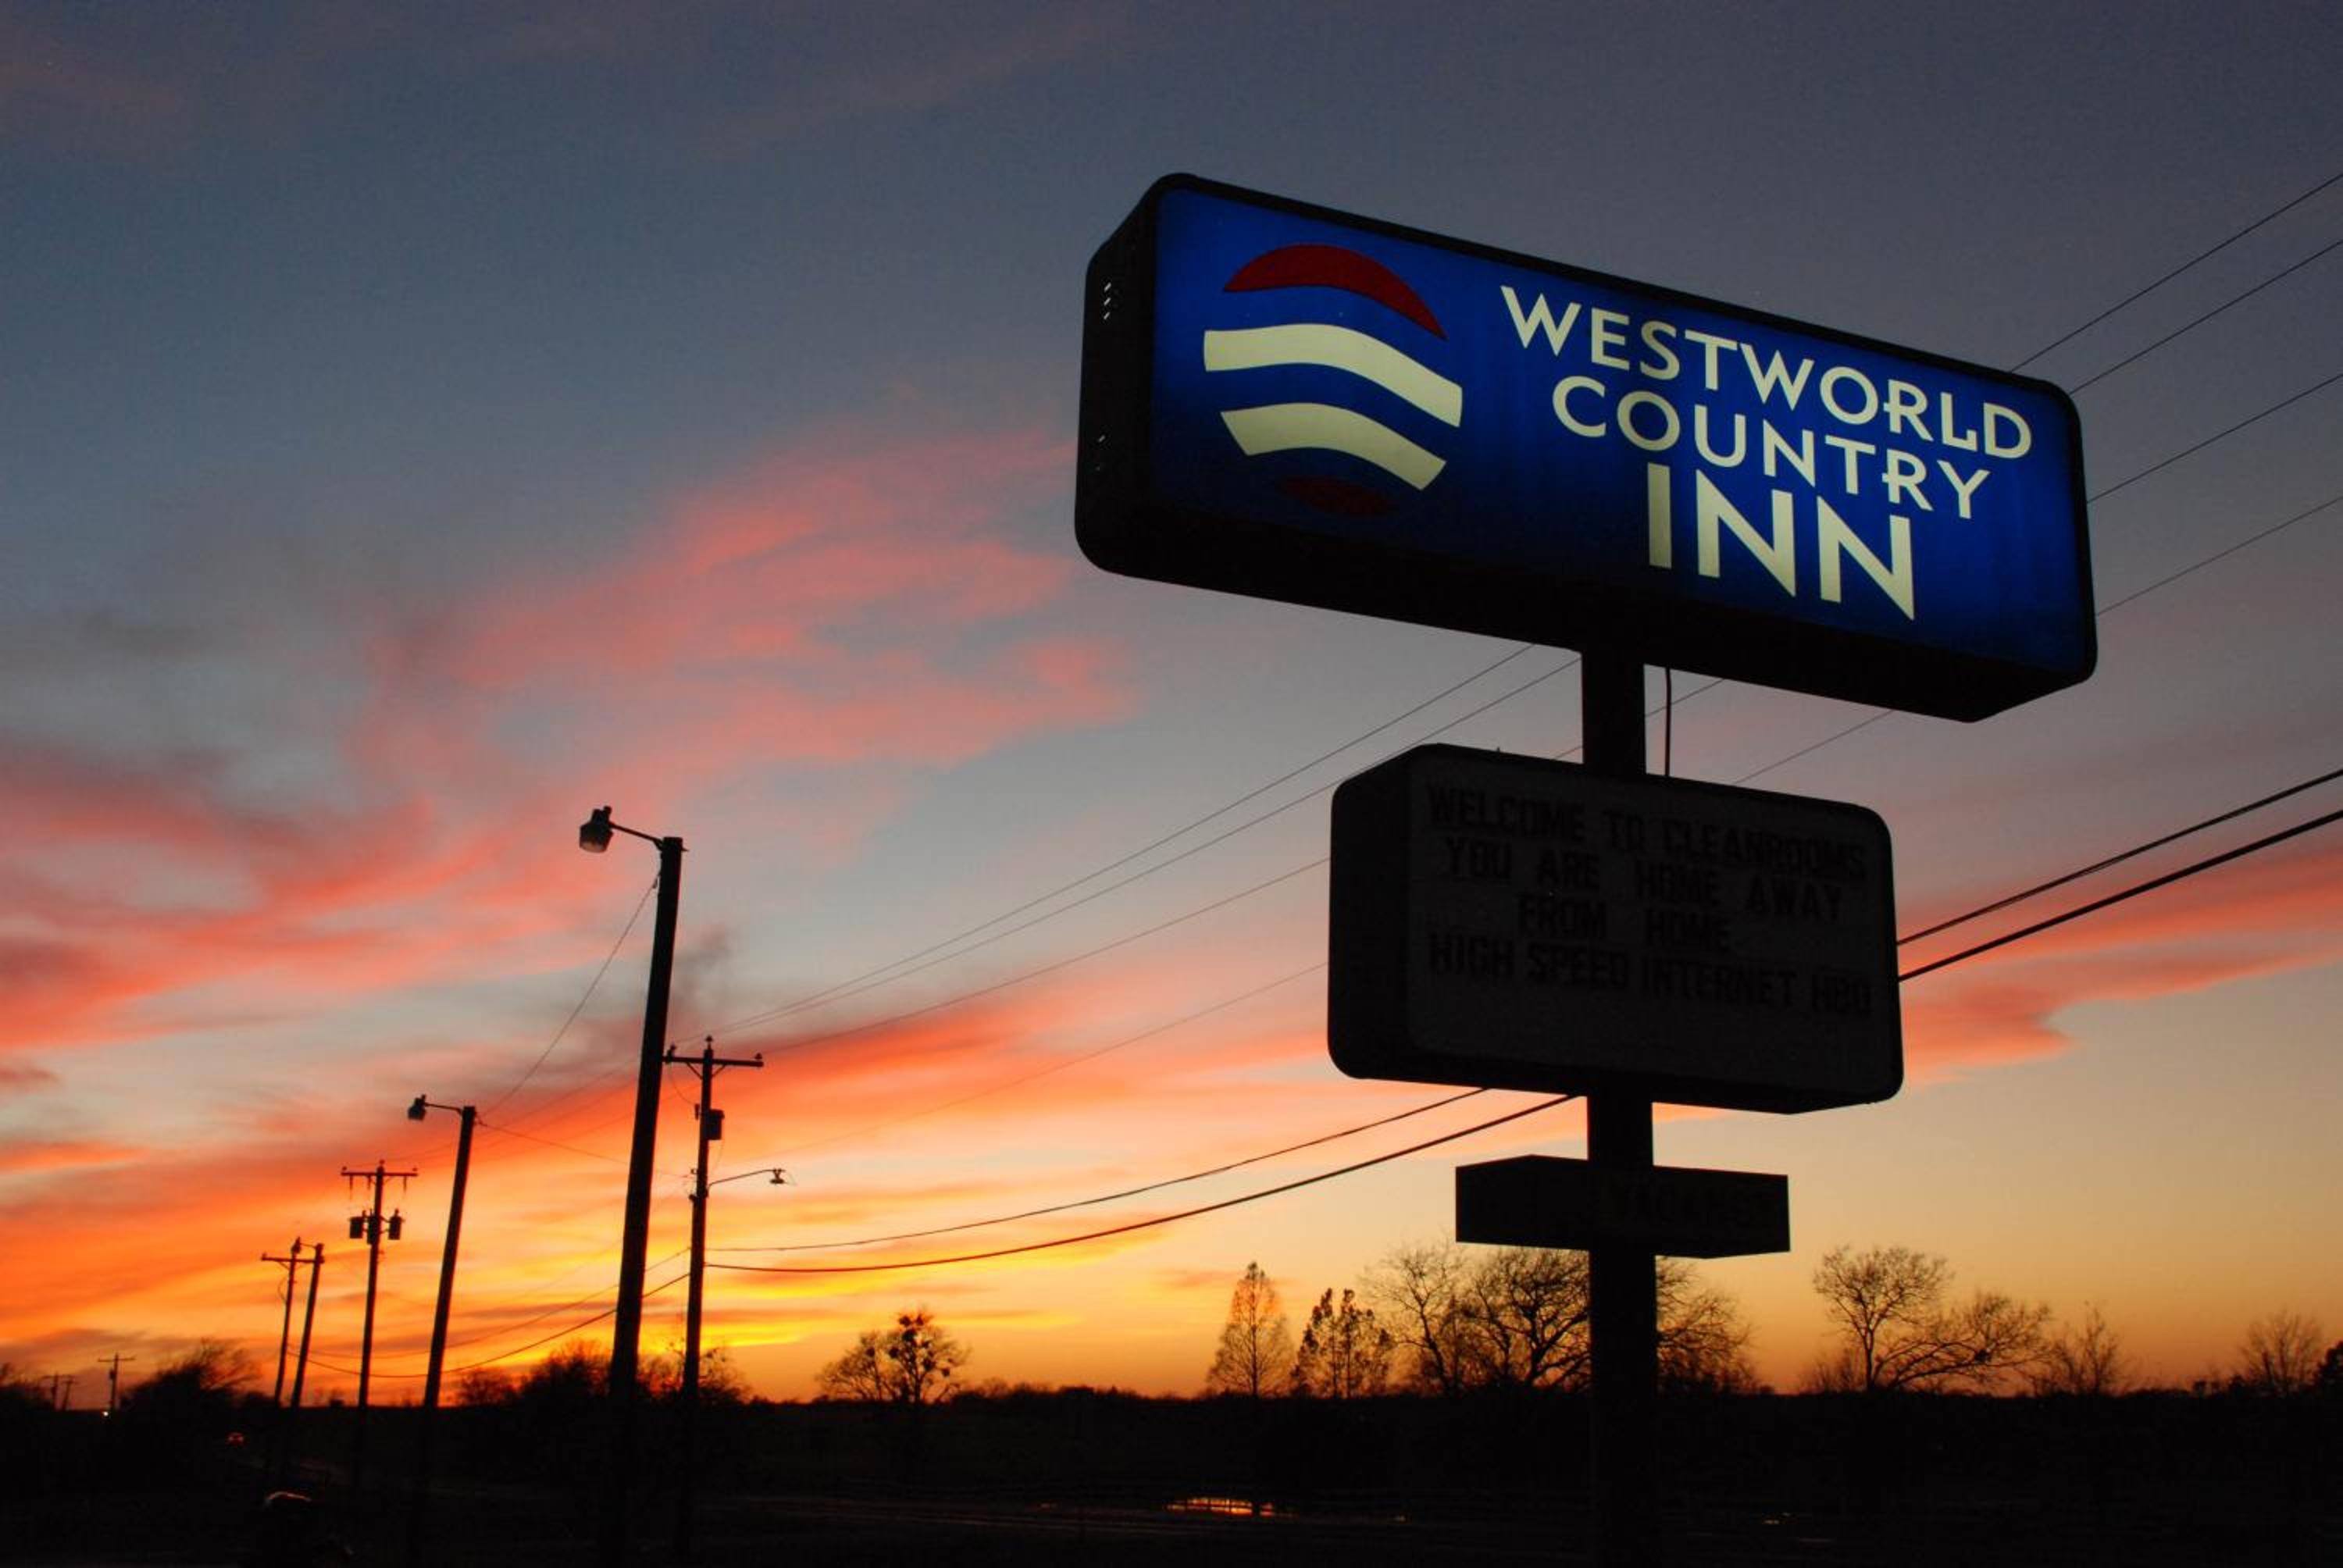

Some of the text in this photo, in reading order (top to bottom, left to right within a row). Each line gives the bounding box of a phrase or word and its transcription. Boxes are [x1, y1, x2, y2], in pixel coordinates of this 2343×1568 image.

[1501, 286, 2031, 458] WESTWORLD
[1553, 376, 1989, 519] COUNTRY
[1649, 465, 1913, 619] INN
[1427, 784, 1866, 881] WELCOME TO CLEANROOMS
[1446, 836, 1842, 920] YOU ARE HOME AWAY
[1517, 893, 1730, 955] FROM HOME
[1428, 932, 1871, 1017] HIGH SPEED INTERNET HBO
